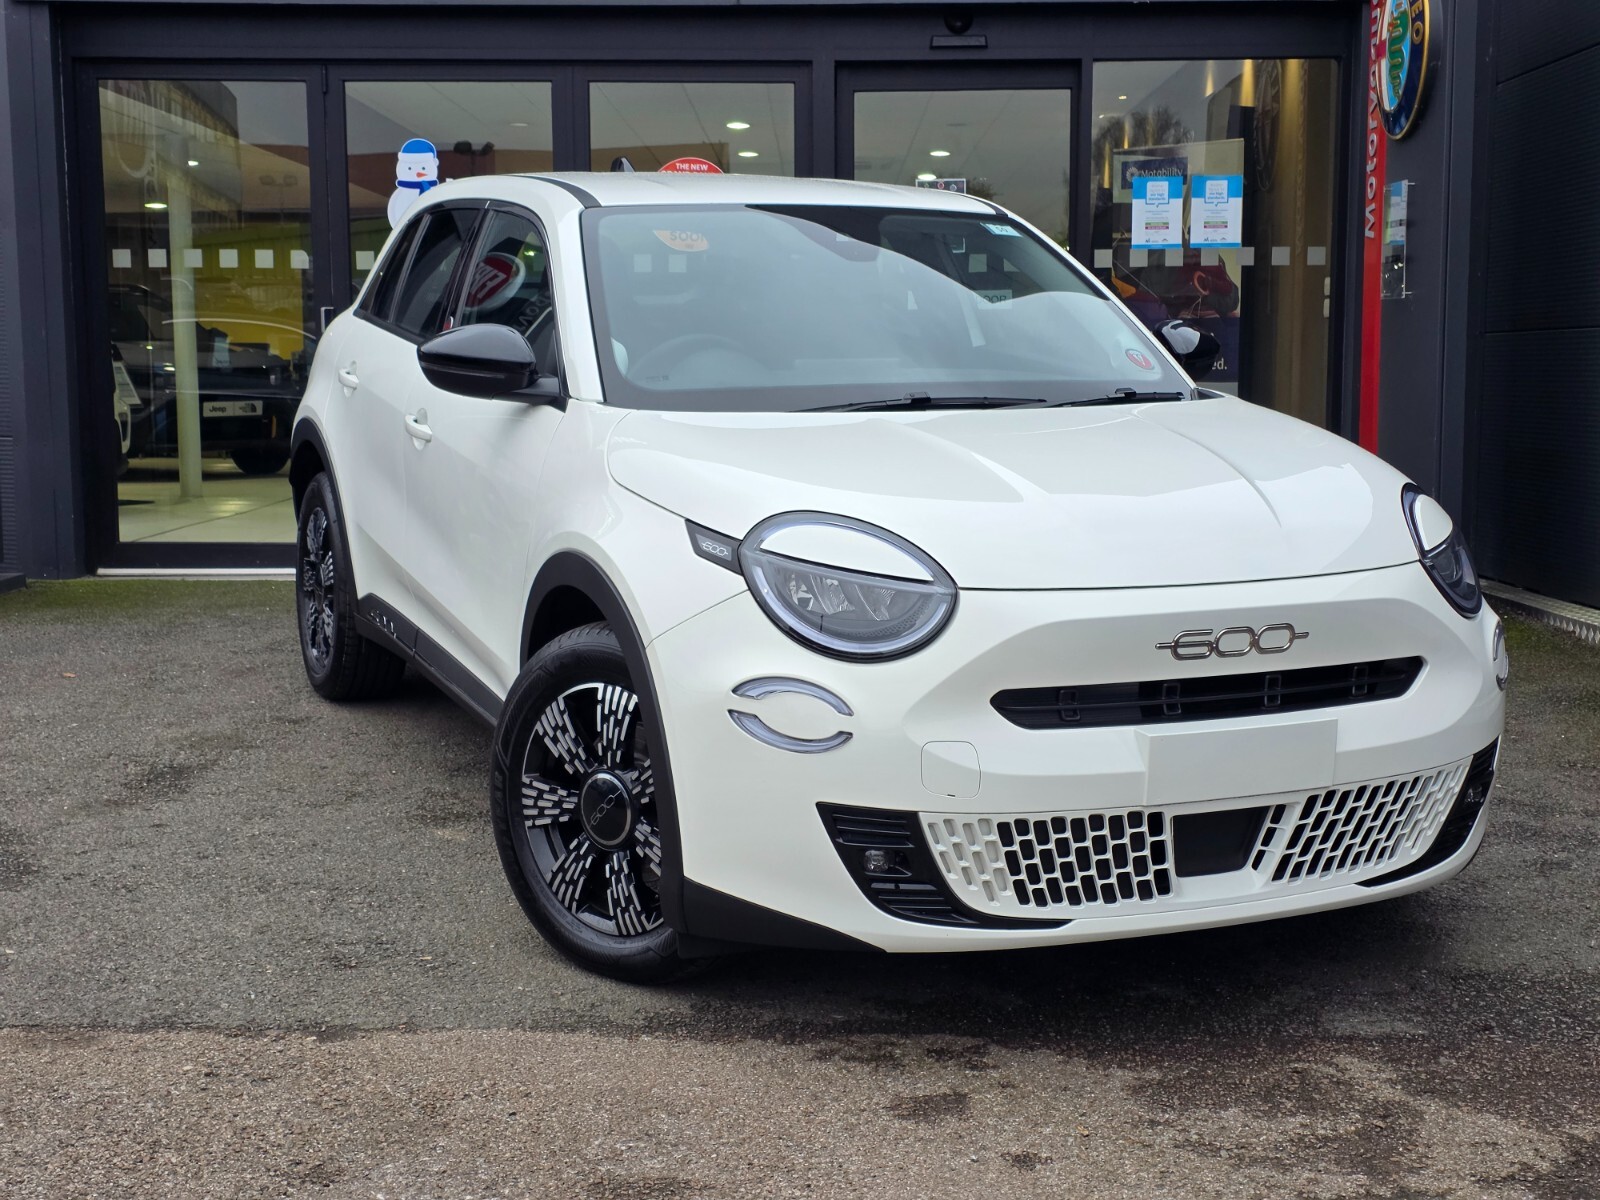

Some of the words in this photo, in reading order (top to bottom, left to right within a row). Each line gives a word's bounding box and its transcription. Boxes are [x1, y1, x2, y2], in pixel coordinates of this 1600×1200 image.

[675, 162, 689, 171] THE
[690, 163, 709, 171] NEW
[209, 405, 227, 413] Jeep
[701, 541, 729, 556] 600
[1155, 622, 1310, 661] 600
[588, 792, 619, 827] 600
